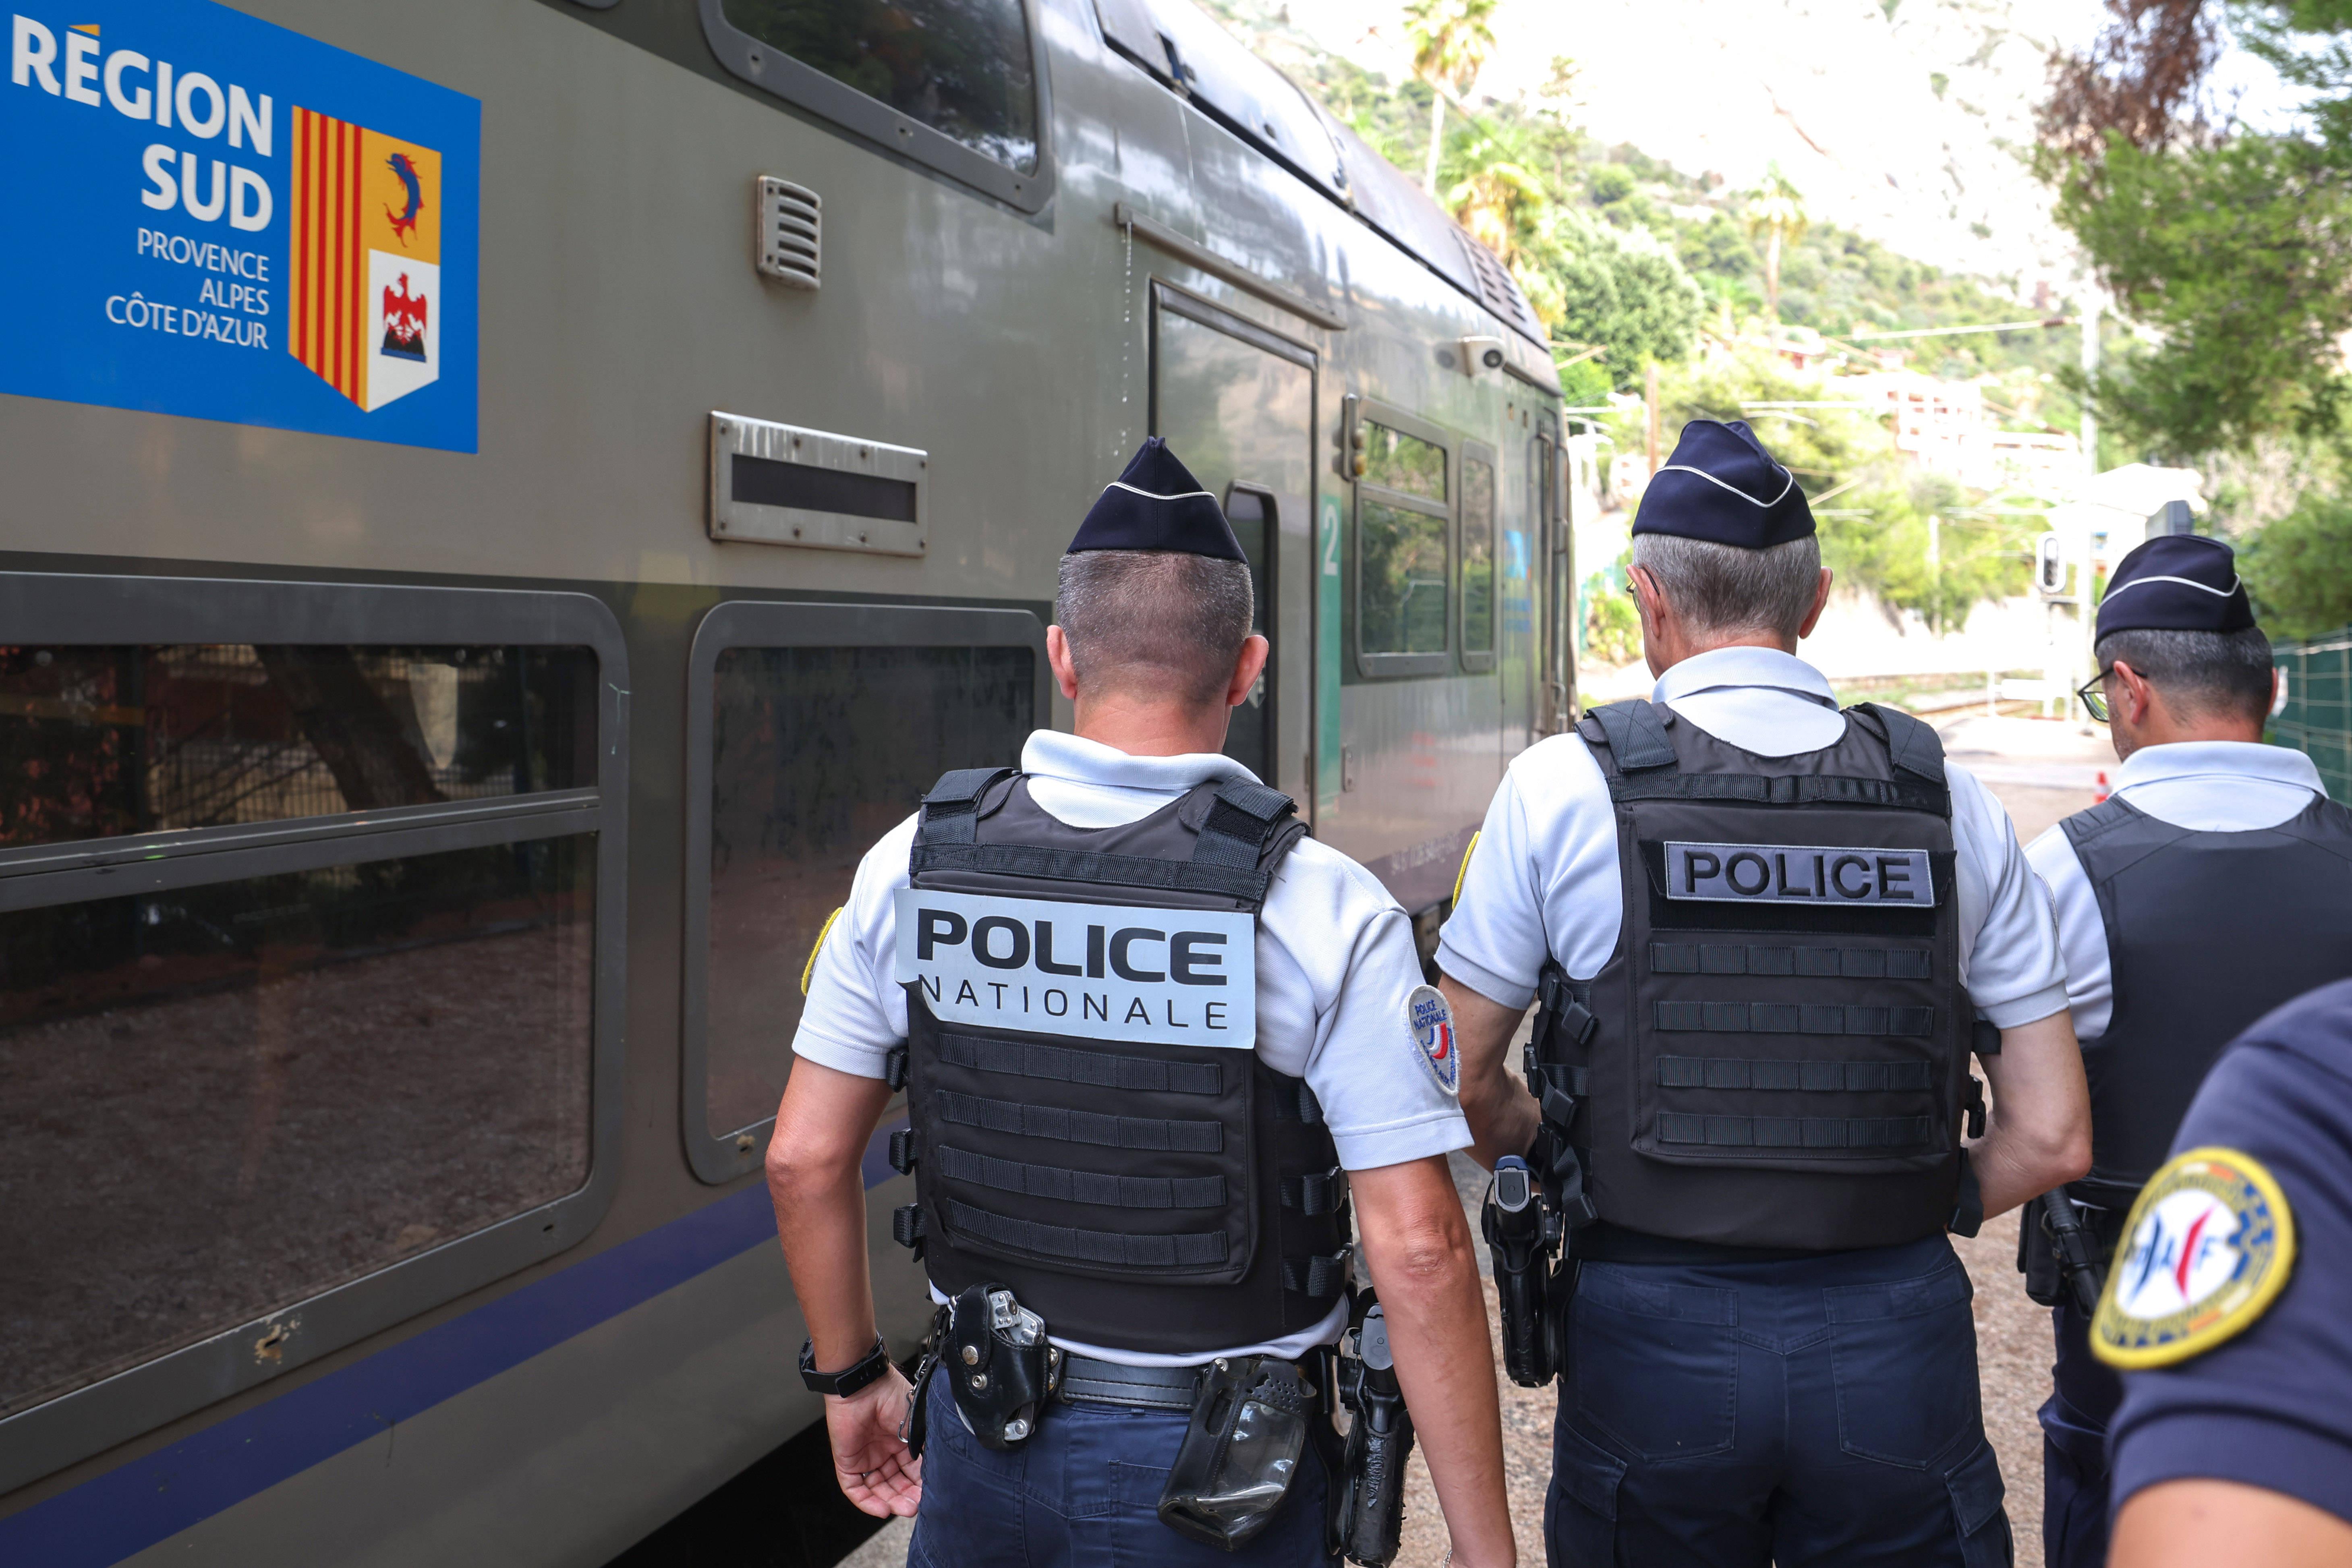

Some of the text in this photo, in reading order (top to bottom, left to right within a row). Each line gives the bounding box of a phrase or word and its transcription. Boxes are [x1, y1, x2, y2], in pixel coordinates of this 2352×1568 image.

[12, 13, 273, 157] RÉGION
[141, 143, 273, 232] SUD
[137, 227, 269, 282] PROVENCE
[106, 292, 269, 350] CÔTE D'AZUR
[199, 278, 269, 315] ALPES
[1324, 504, 1338, 576] 2
[1683, 850, 1914, 899] POLICE
[917, 908, 1227, 986] POLICE
[918, 974, 1227, 1030] NATIONALE
[1413, 1009, 1447, 1030] NATIONALE
[1415, 999, 1436, 1016] POLICE
